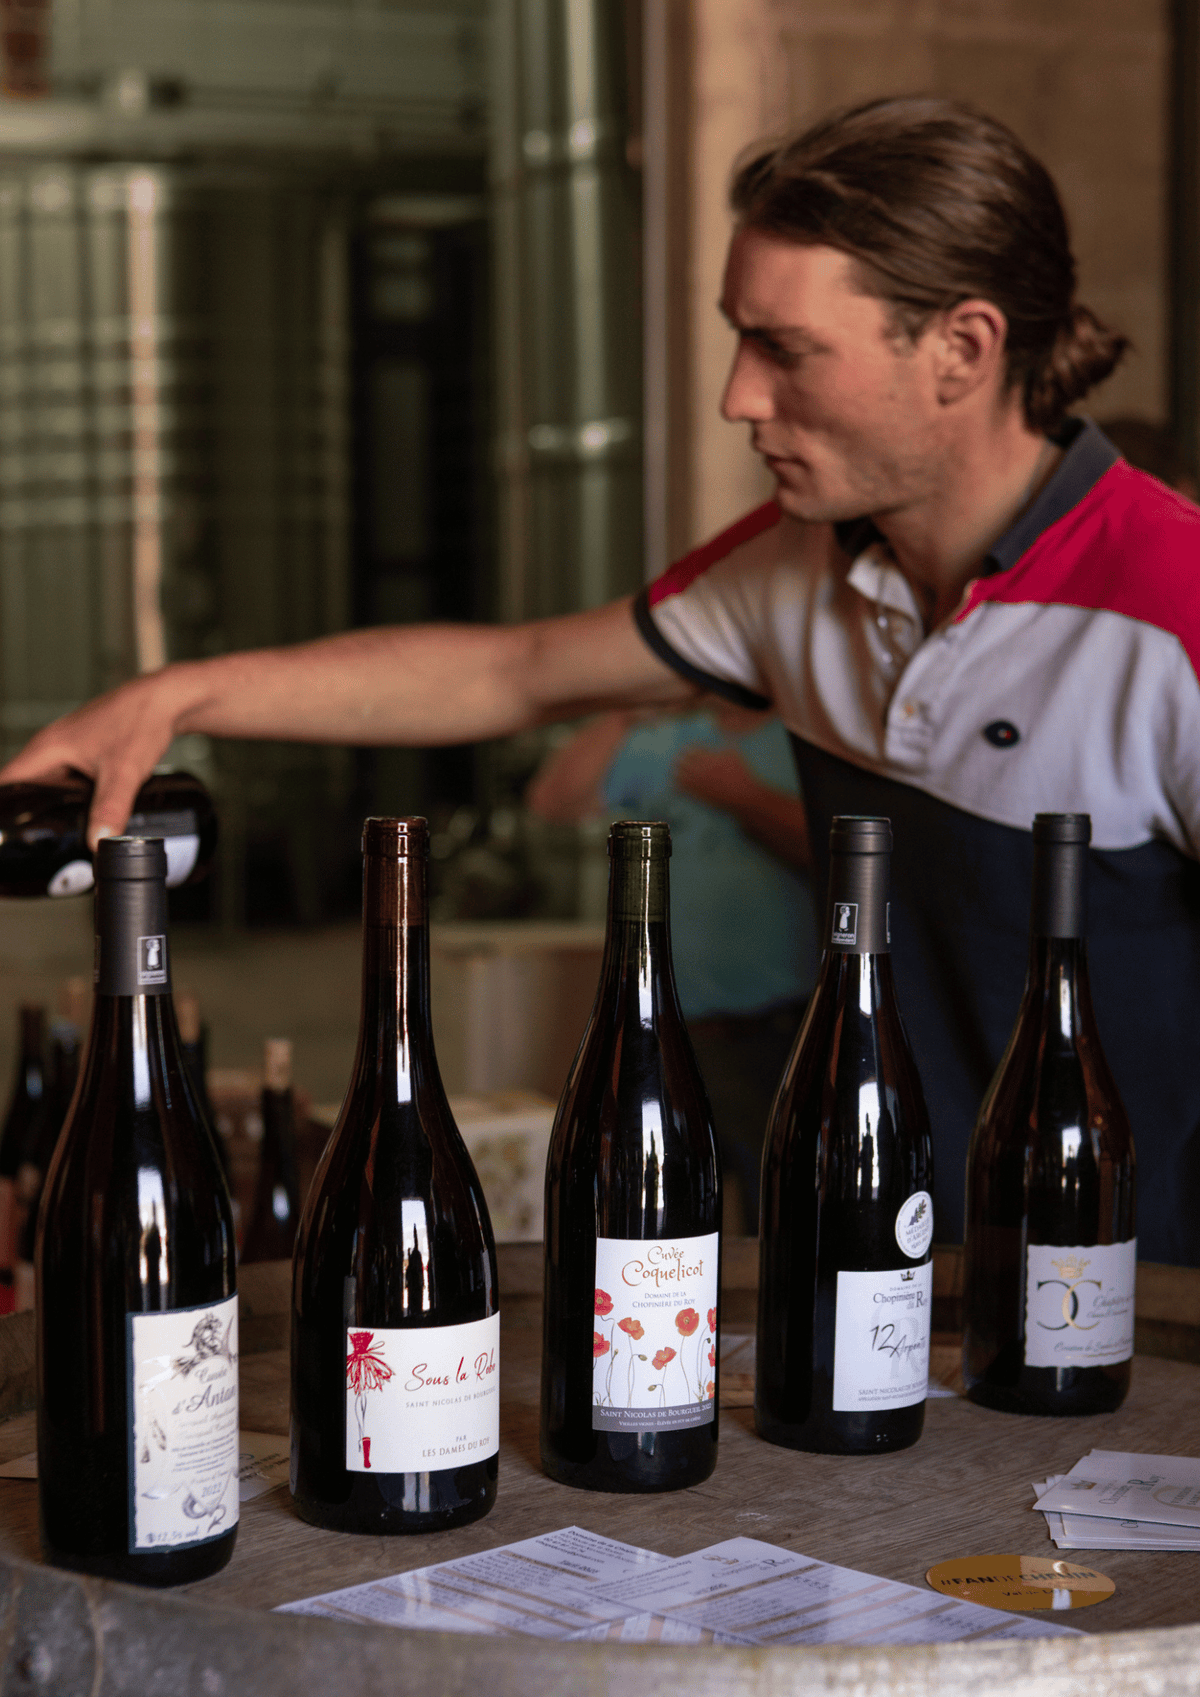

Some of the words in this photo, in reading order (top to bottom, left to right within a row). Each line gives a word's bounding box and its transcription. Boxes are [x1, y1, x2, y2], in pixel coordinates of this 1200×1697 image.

[647, 1245, 685, 1265] Cuvée
[621, 1258, 704, 1288] Coquelicot
[869, 1323, 895, 1352] 12
[404, 1362, 451, 1392] Sous
[455, 1355, 469, 1384] la
[405, 1400, 429, 1409] SAINT
[431, 1396, 463, 1407] NICOLAS
[463, 1394, 472, 1402] DE
[600, 1408, 622, 1418] SAINT
[623, 1410, 656, 1419] NICOLAS
[422, 1449, 436, 1458] LES
[439, 1445, 466, 1456] DAMES
[467, 1441, 478, 1451] DU
[479, 1436, 491, 1447] ROY
[455, 1434, 467, 1443] PAR
